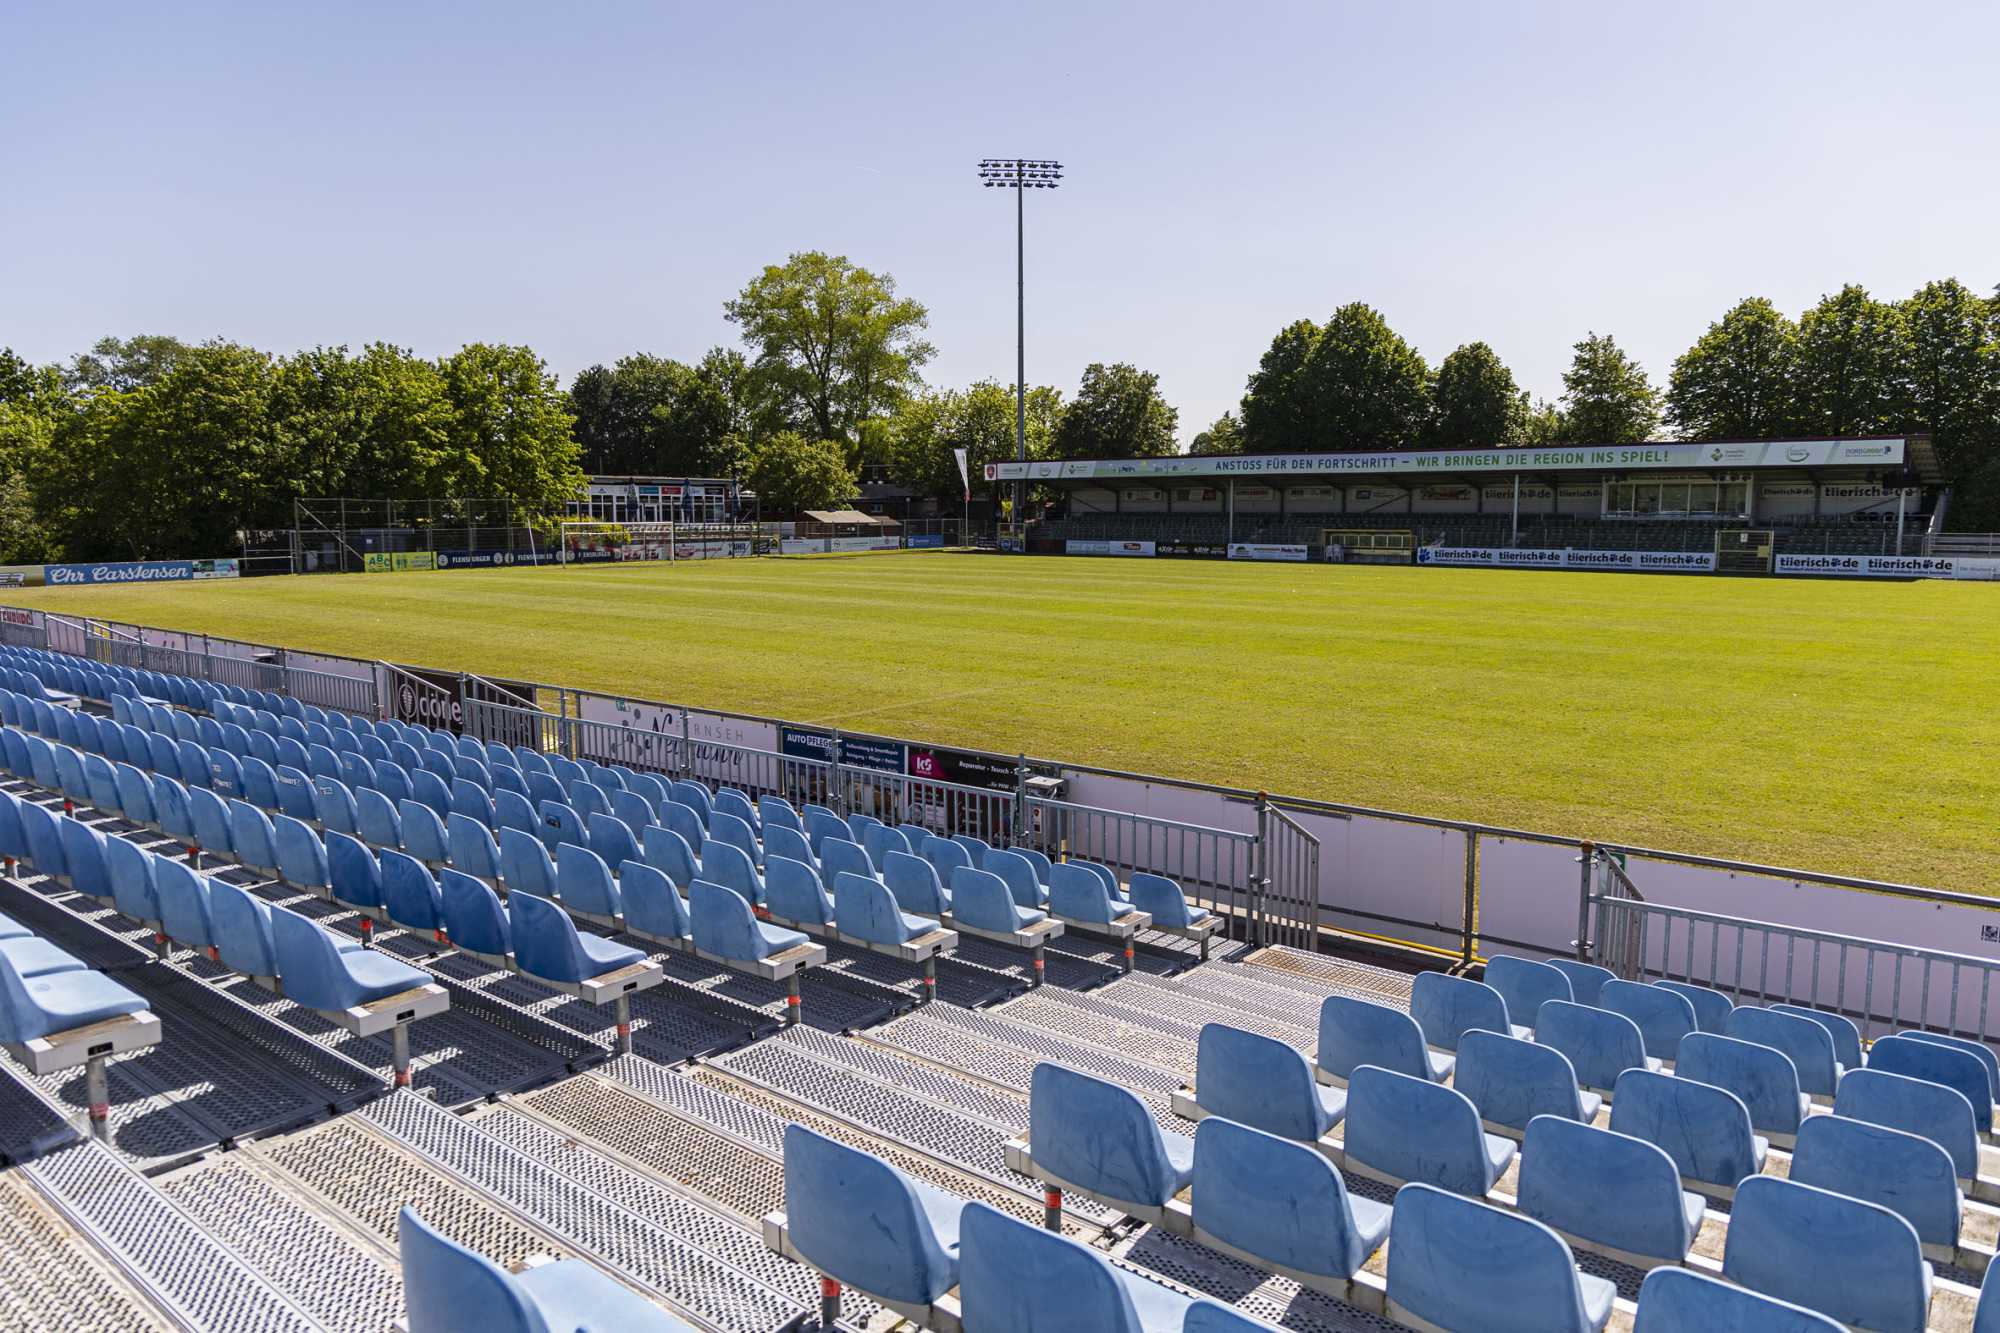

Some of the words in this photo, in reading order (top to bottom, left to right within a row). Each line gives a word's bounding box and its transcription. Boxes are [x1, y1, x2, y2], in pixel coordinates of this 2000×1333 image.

[1215, 459, 1262, 471] ANSTOSS
[1266, 457, 1287, 470] FÜR
[1291, 458, 1313, 470] DEN
[1318, 457, 1397, 469] FORTSCHRITT
[1416, 456, 1439, 467] WIR
[1444, 455, 1500, 466] BRINGEN
[1506, 454, 1527, 465] DIE
[1534, 453, 1584, 464] REGION
[1591, 452, 1614, 463] INS
[1620, 450, 1669, 463] SPIEL!
[51, 567, 86, 584] Chr
[92, 565, 189, 582] Carstensen
[675, 719, 744, 742] FRNSEH
[787, 733, 806, 744] AUTO
